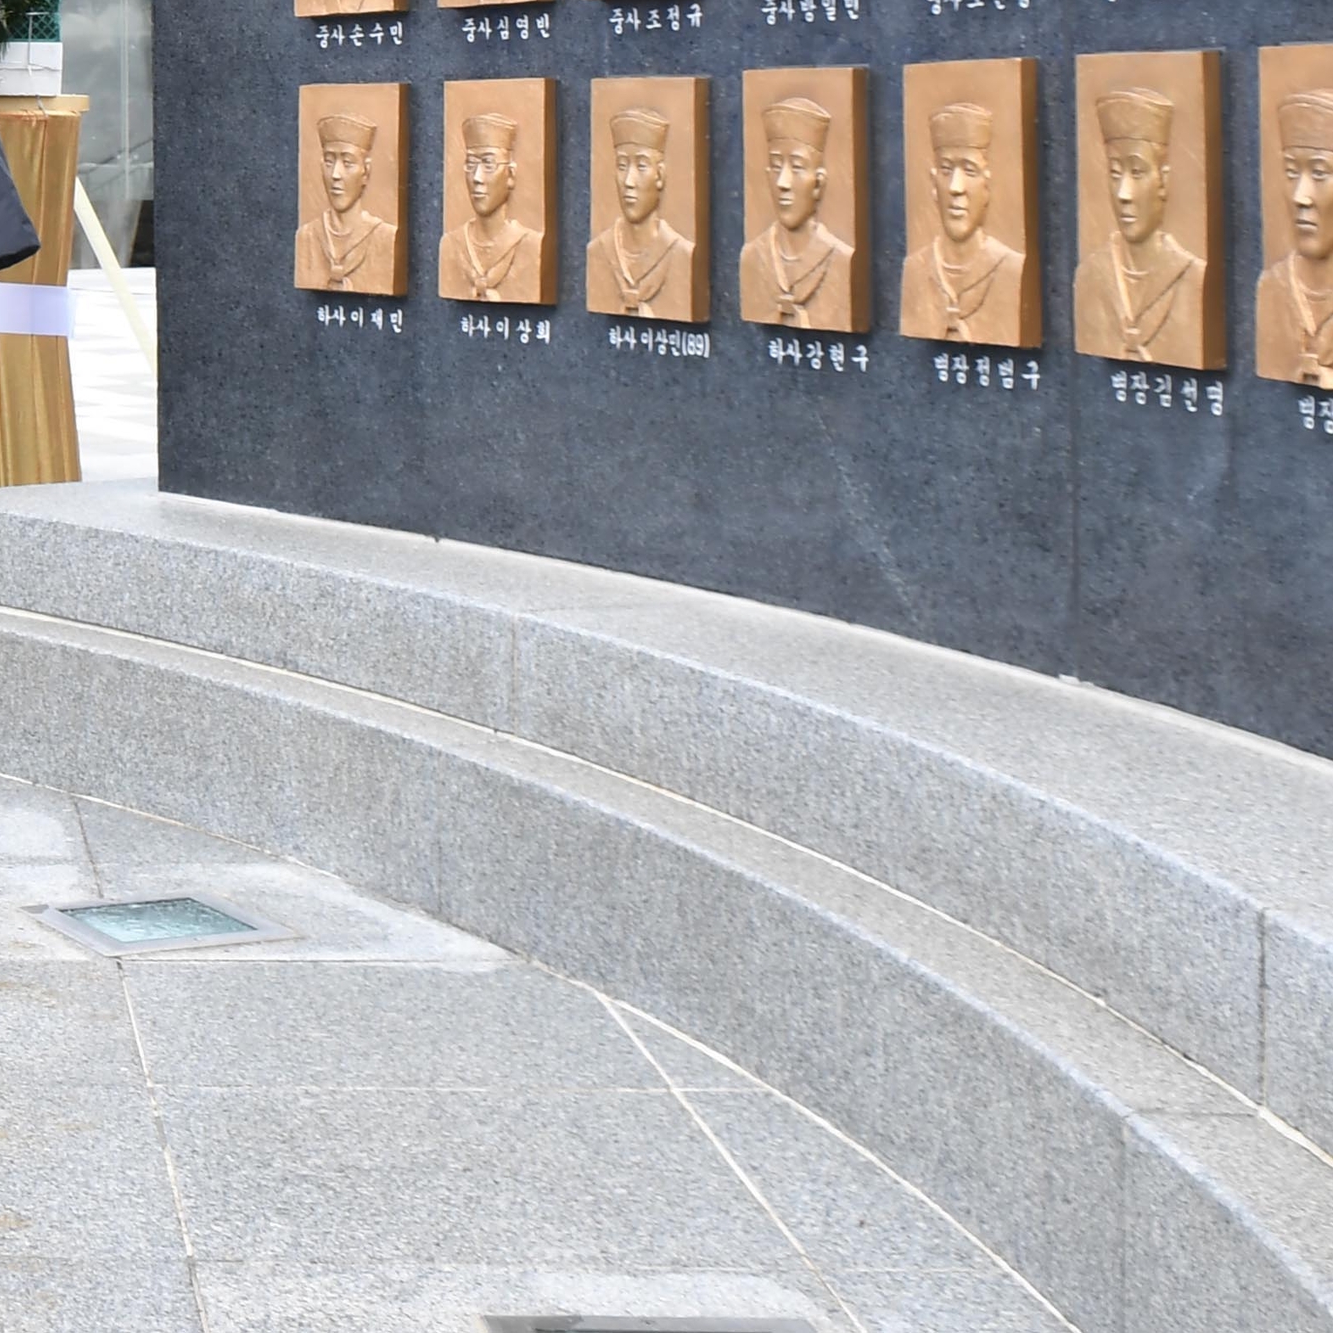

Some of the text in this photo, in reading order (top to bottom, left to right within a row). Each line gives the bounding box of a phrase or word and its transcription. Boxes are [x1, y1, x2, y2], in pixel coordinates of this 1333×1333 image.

[461, 17, 493, 43] 중사
[609, 8, 641, 35] 중사
[315, 24, 346, 49] 중사
[316, 304, 346, 330] 하사
[460, 313, 491, 339] 하사
[608, 325, 637, 351] 하사
[767, 337, 803, 365] 하사
[933, 352, 970, 385] 병장
[1110, 369, 1150, 405] 병장
